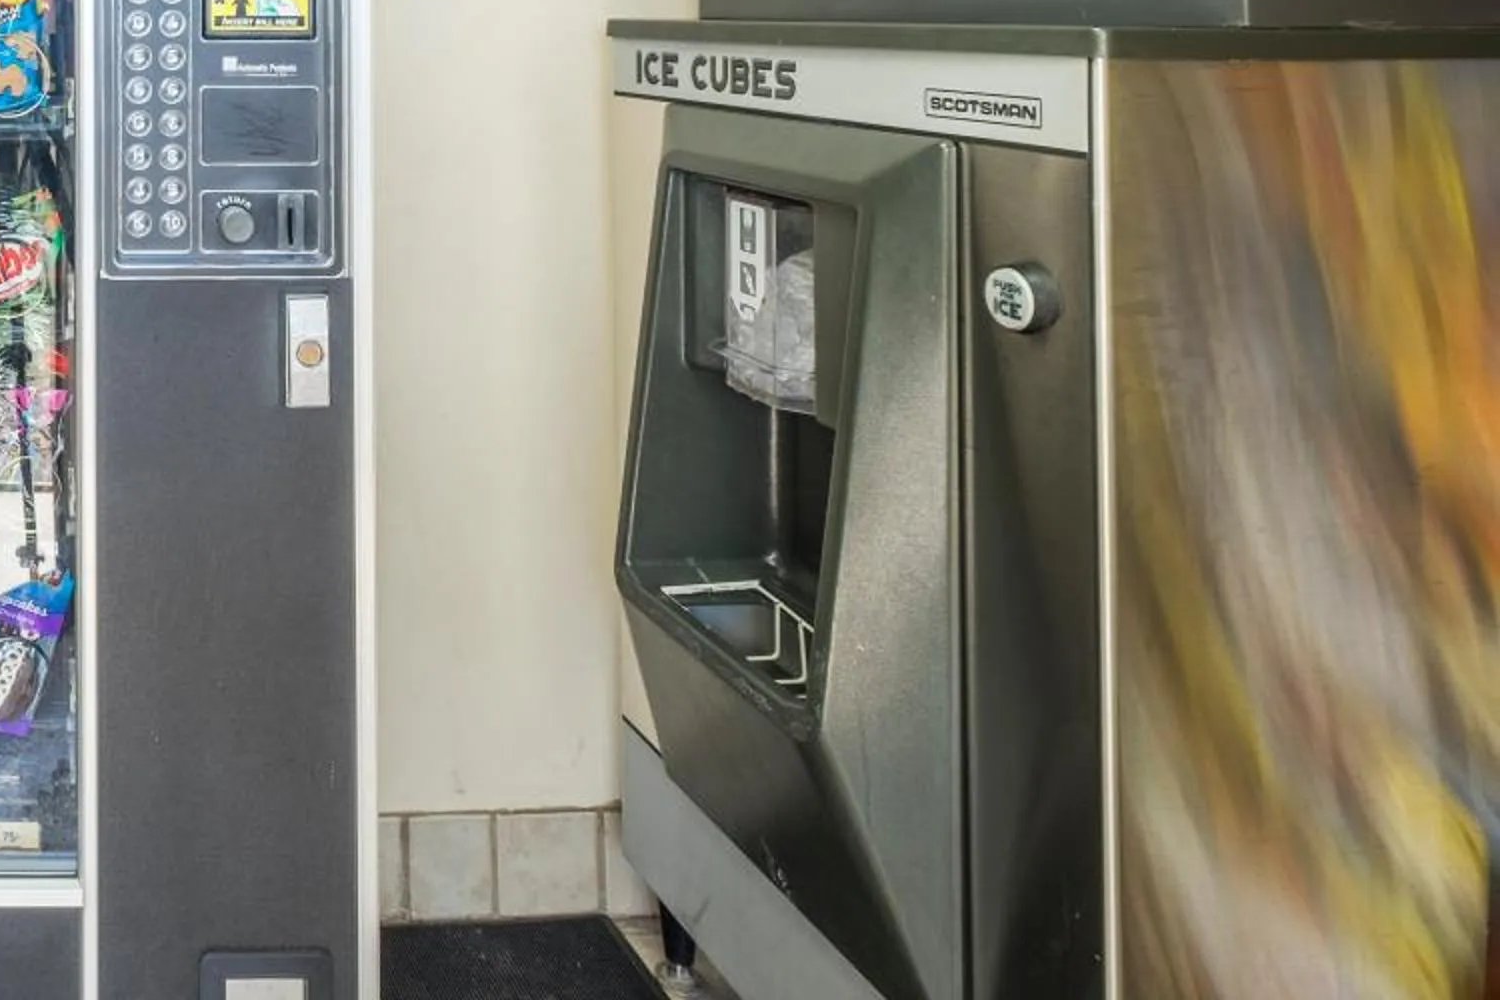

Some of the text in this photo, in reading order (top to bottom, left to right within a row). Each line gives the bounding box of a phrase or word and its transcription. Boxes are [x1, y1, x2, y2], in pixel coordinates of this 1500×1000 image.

[635, 49, 798, 100] ICE CUBES
[929, 96, 1037, 122] SCOTSMAN
[994, 297, 1023, 320] ICE
